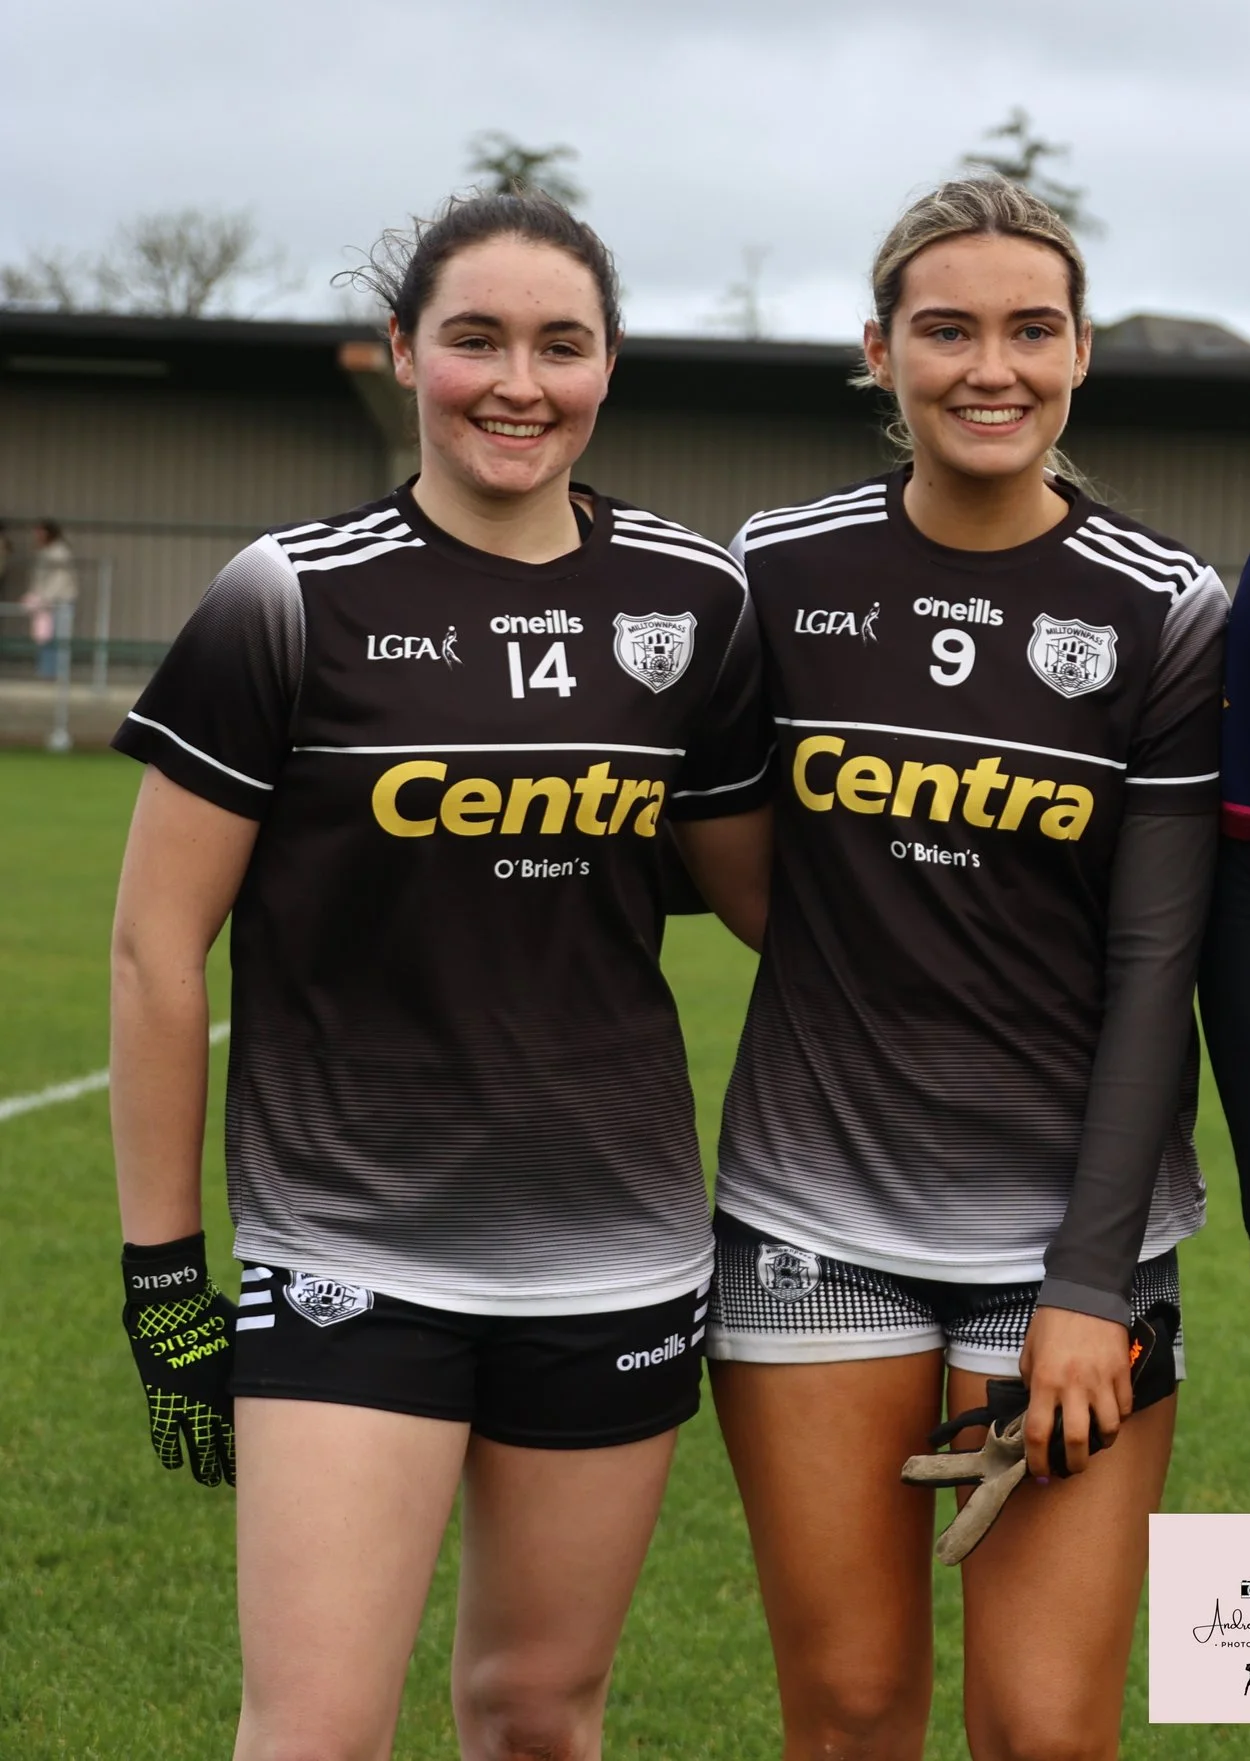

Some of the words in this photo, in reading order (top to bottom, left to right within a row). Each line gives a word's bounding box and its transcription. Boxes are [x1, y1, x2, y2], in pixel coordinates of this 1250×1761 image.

[628, 621, 687, 634] MILLTOWNPASS
[794, 608, 860, 638] LGFA
[1046, 627, 1104, 645] MILLTOWNPASS
[367, 634, 442, 661] LGFA
[929, 628, 977, 688] 9
[507, 641, 577, 699] 14
[371, 760, 665, 839] Centra
[792, 733, 1095, 841] Centra
[890, 839, 981, 868] O'Brien's
[494, 858, 591, 880] O'Brien's
[167, 1336, 229, 1369] KARAKAL
